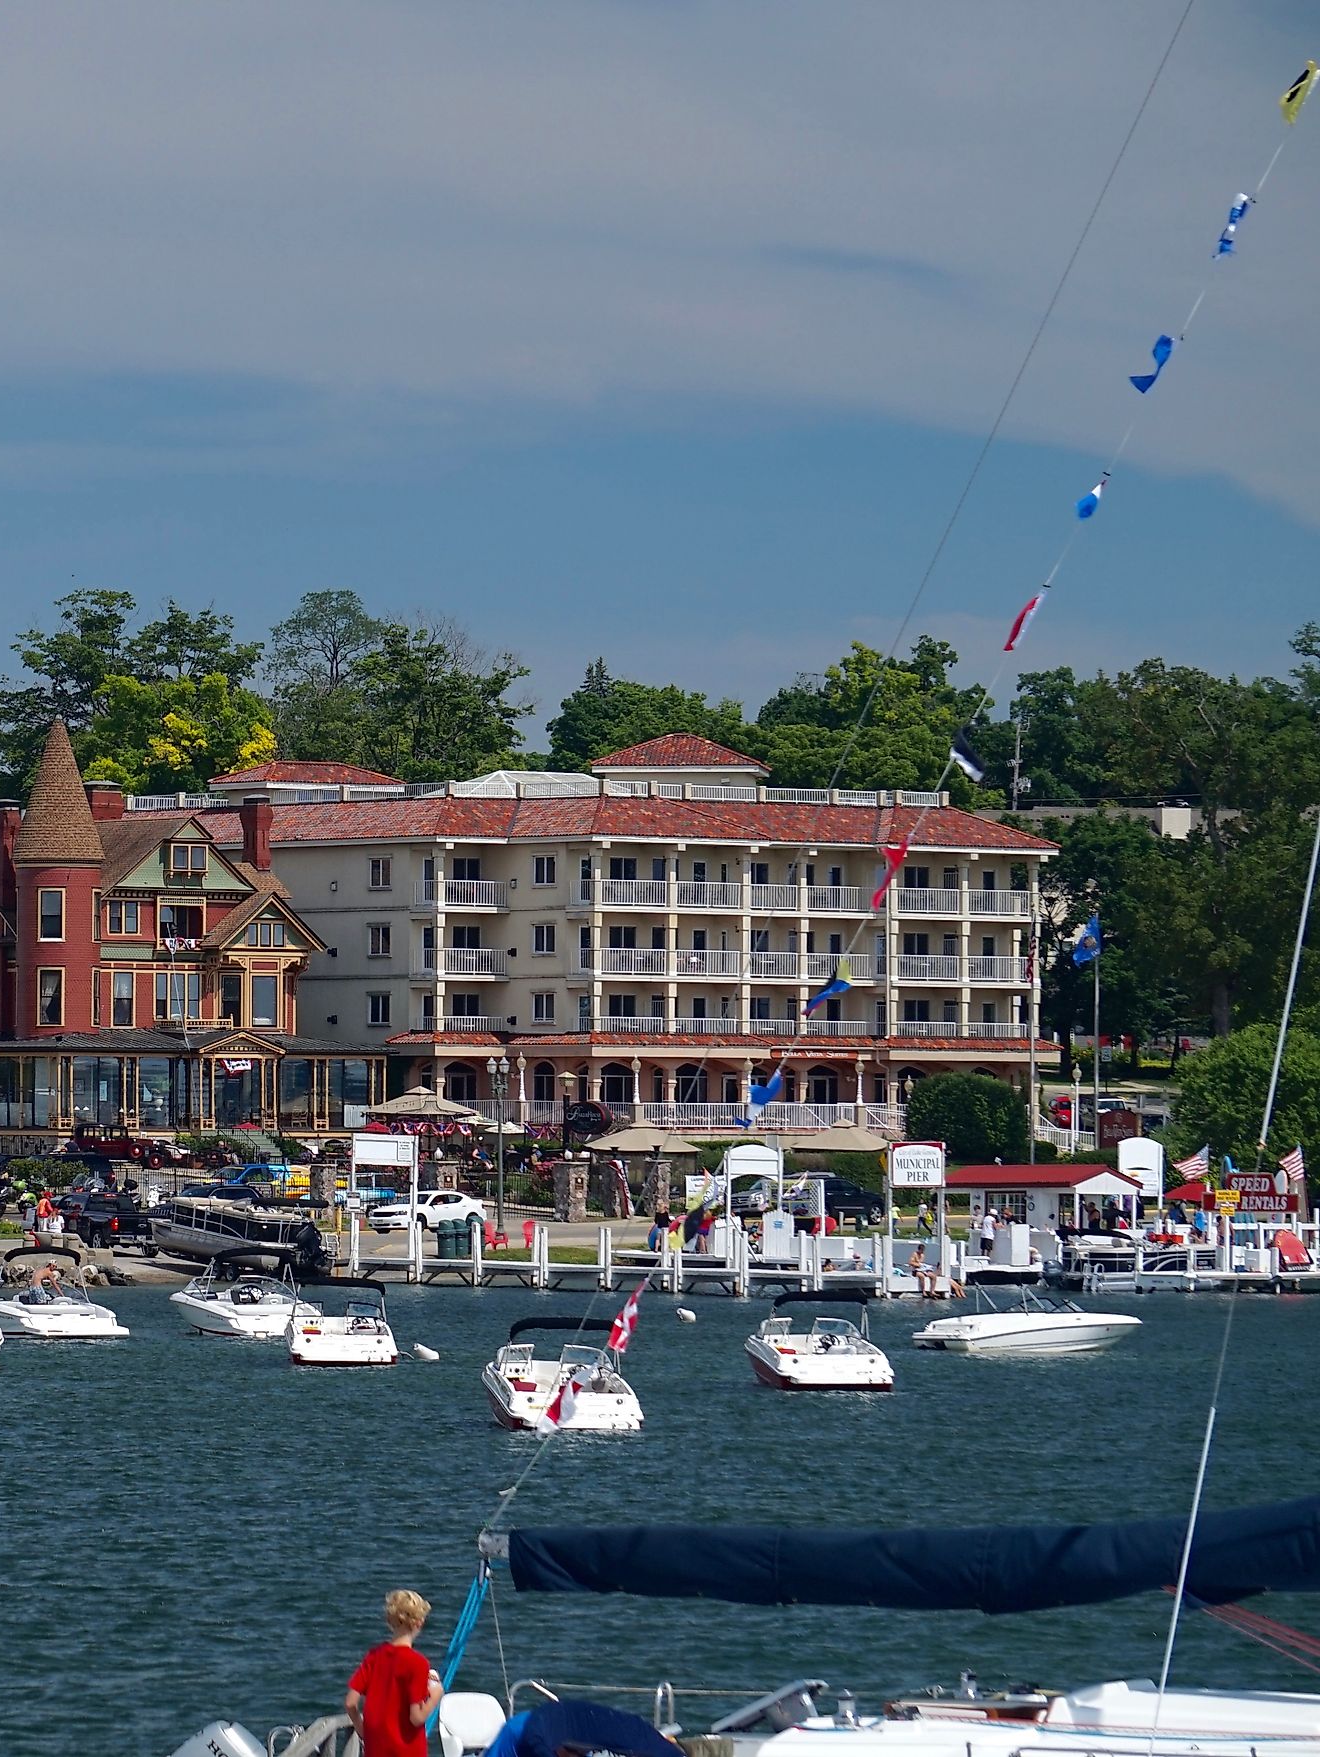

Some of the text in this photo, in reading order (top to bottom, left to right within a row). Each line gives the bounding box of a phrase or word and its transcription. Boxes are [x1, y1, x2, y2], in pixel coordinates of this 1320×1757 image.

[781, 1050, 802, 1058] BELLA
[805, 1050, 823, 1058] VISTA
[895, 1158, 940, 1169] MUNICIPAL
[907, 1171, 929, 1182] PIER
[1231, 1178, 1270, 1192] SPEED
[1241, 1196, 1287, 1210] RENTALS
